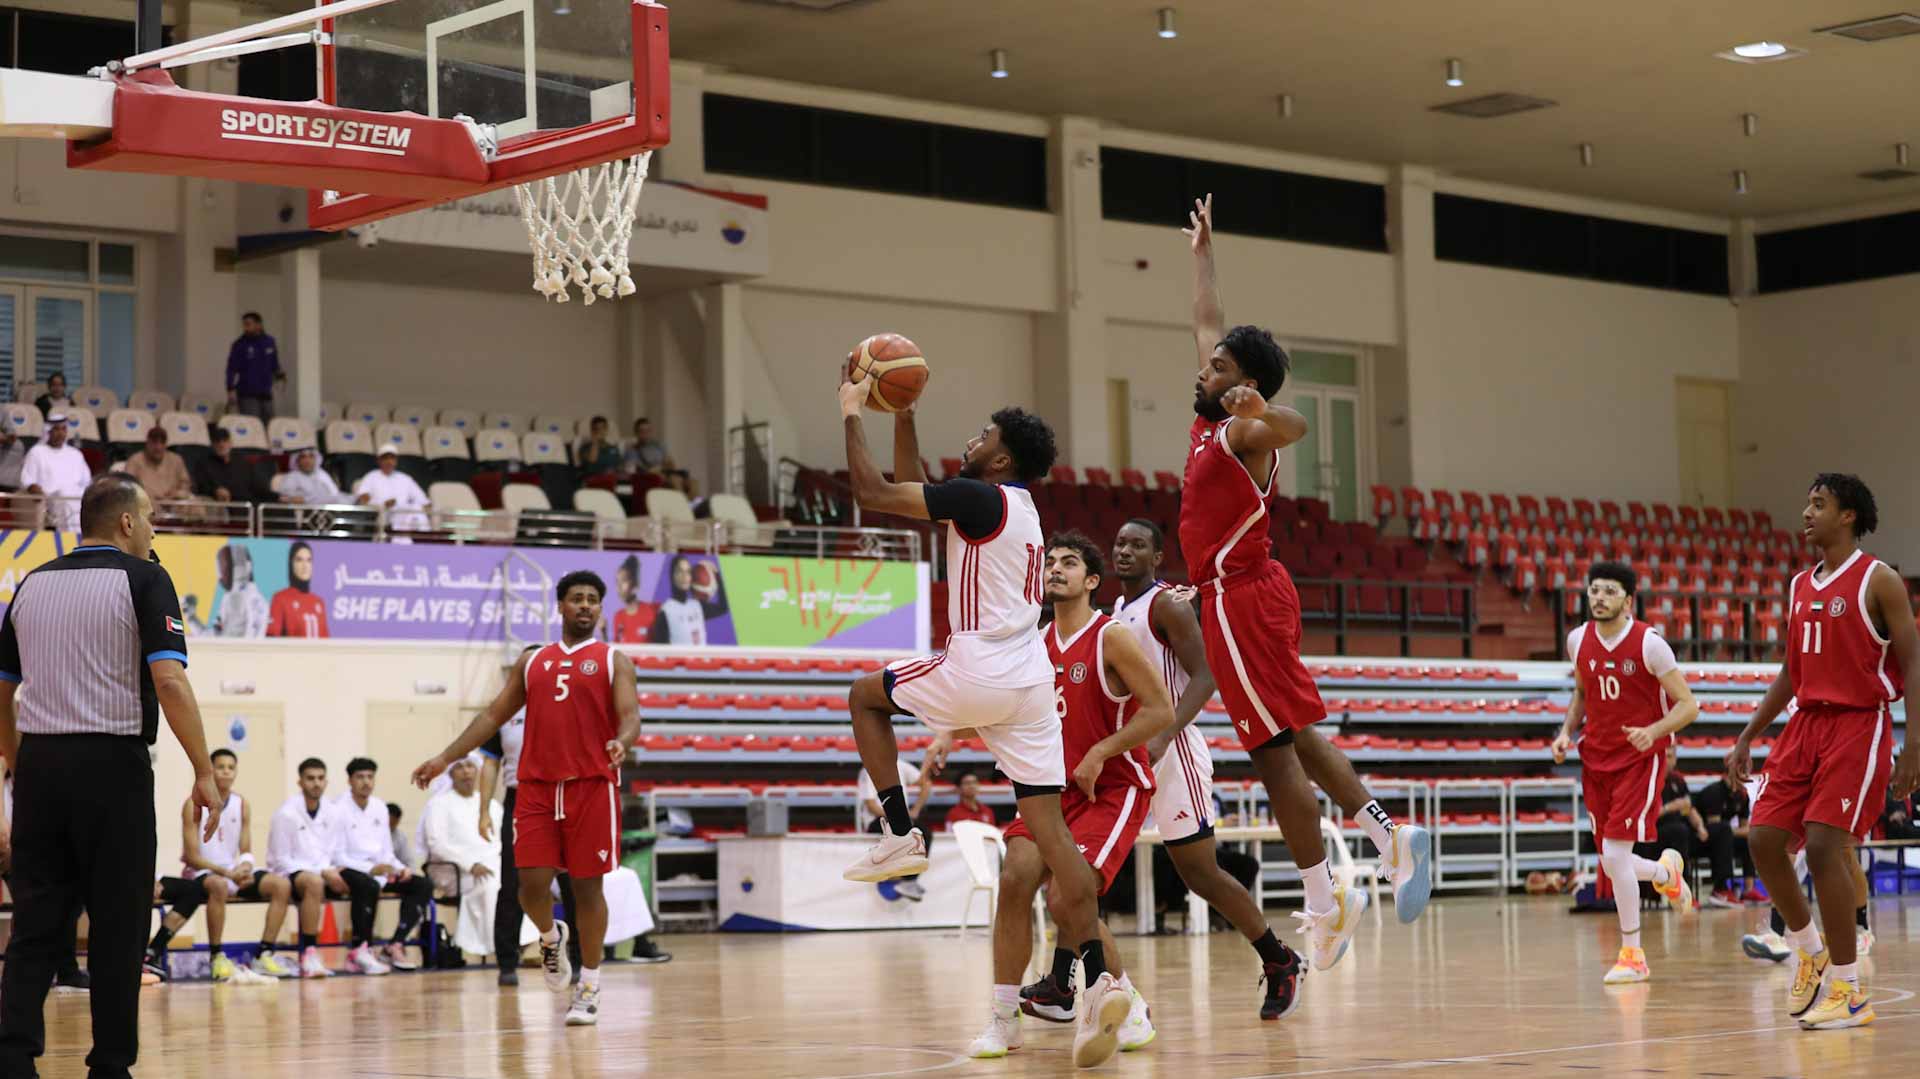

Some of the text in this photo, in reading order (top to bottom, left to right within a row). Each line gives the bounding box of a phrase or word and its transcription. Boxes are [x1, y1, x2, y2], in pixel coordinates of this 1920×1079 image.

[333, 597, 383, 620] SHE
[1802, 621, 1822, 654] 11
[554, 674, 571, 702] 5
[1598, 675, 1620, 700] 10
